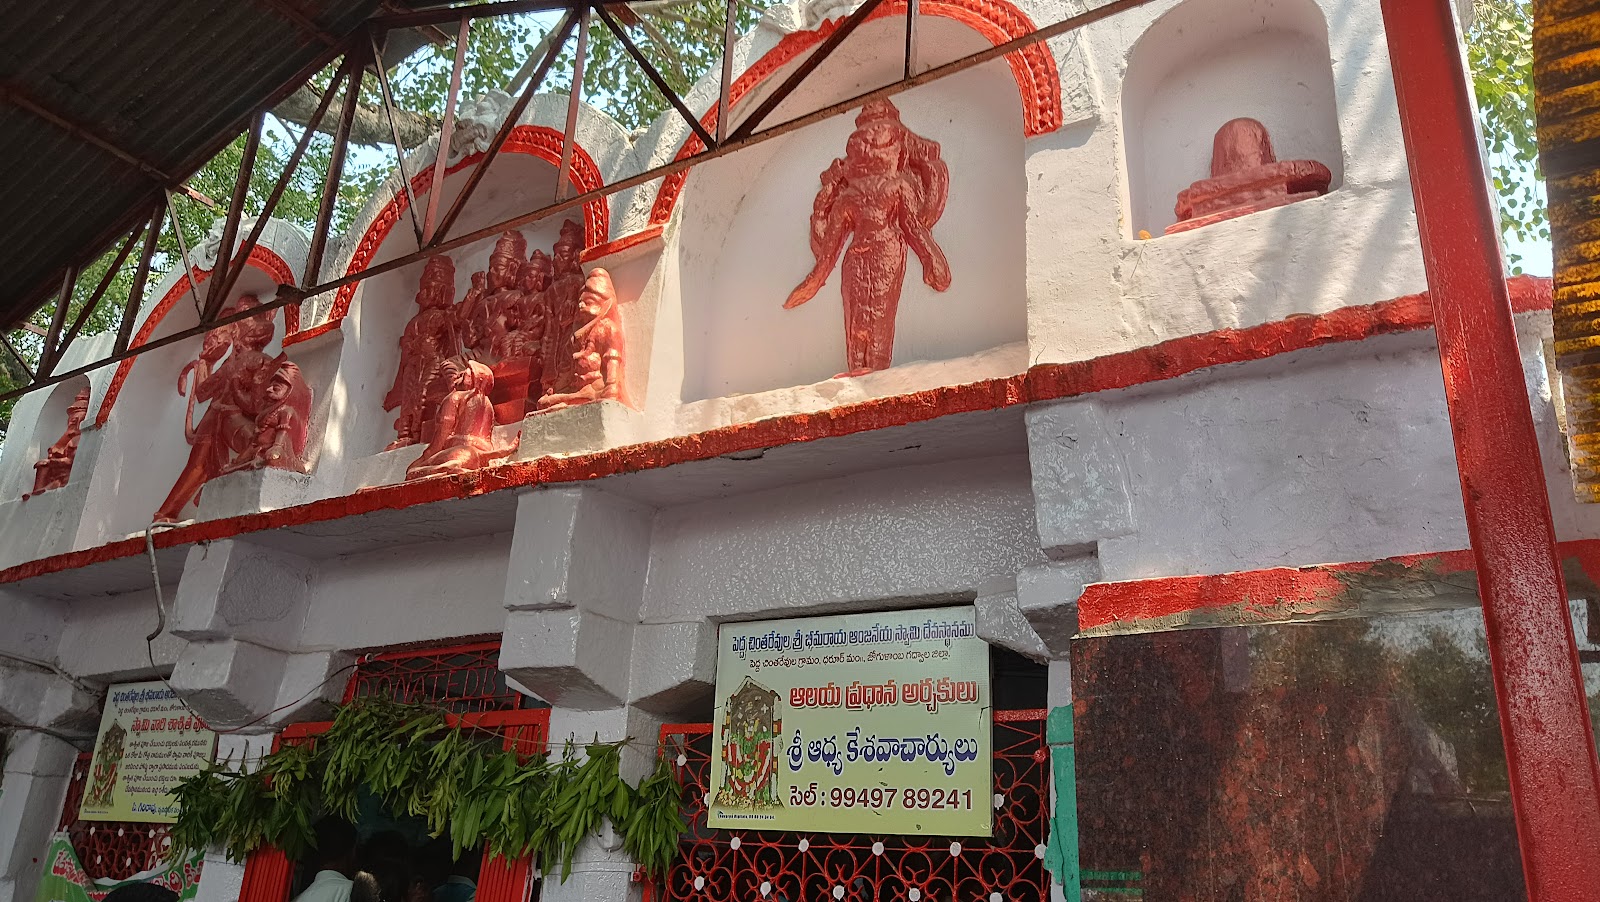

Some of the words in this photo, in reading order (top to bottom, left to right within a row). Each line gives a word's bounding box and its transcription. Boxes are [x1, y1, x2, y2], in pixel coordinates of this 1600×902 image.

[792, 629, 804, 652] శ్రీ
[849, 623, 893, 644] ఆంజనేయ
[894, 624, 921, 645] స్వామి
[923, 619, 975, 647] దేవస్థానము
[789, 683, 841, 707] ఆలయ
[845, 680, 898, 709] ప్రధాన
[902, 677, 978, 713] అర్చకులు
[787, 729, 803, 771] శ్రీ
[807, 735, 843, 775] ఆధ్య
[846, 726, 978, 775] కేశవాచార్యులు
[830, 787, 898, 809] 99497
[903, 788, 973, 810] 89241
